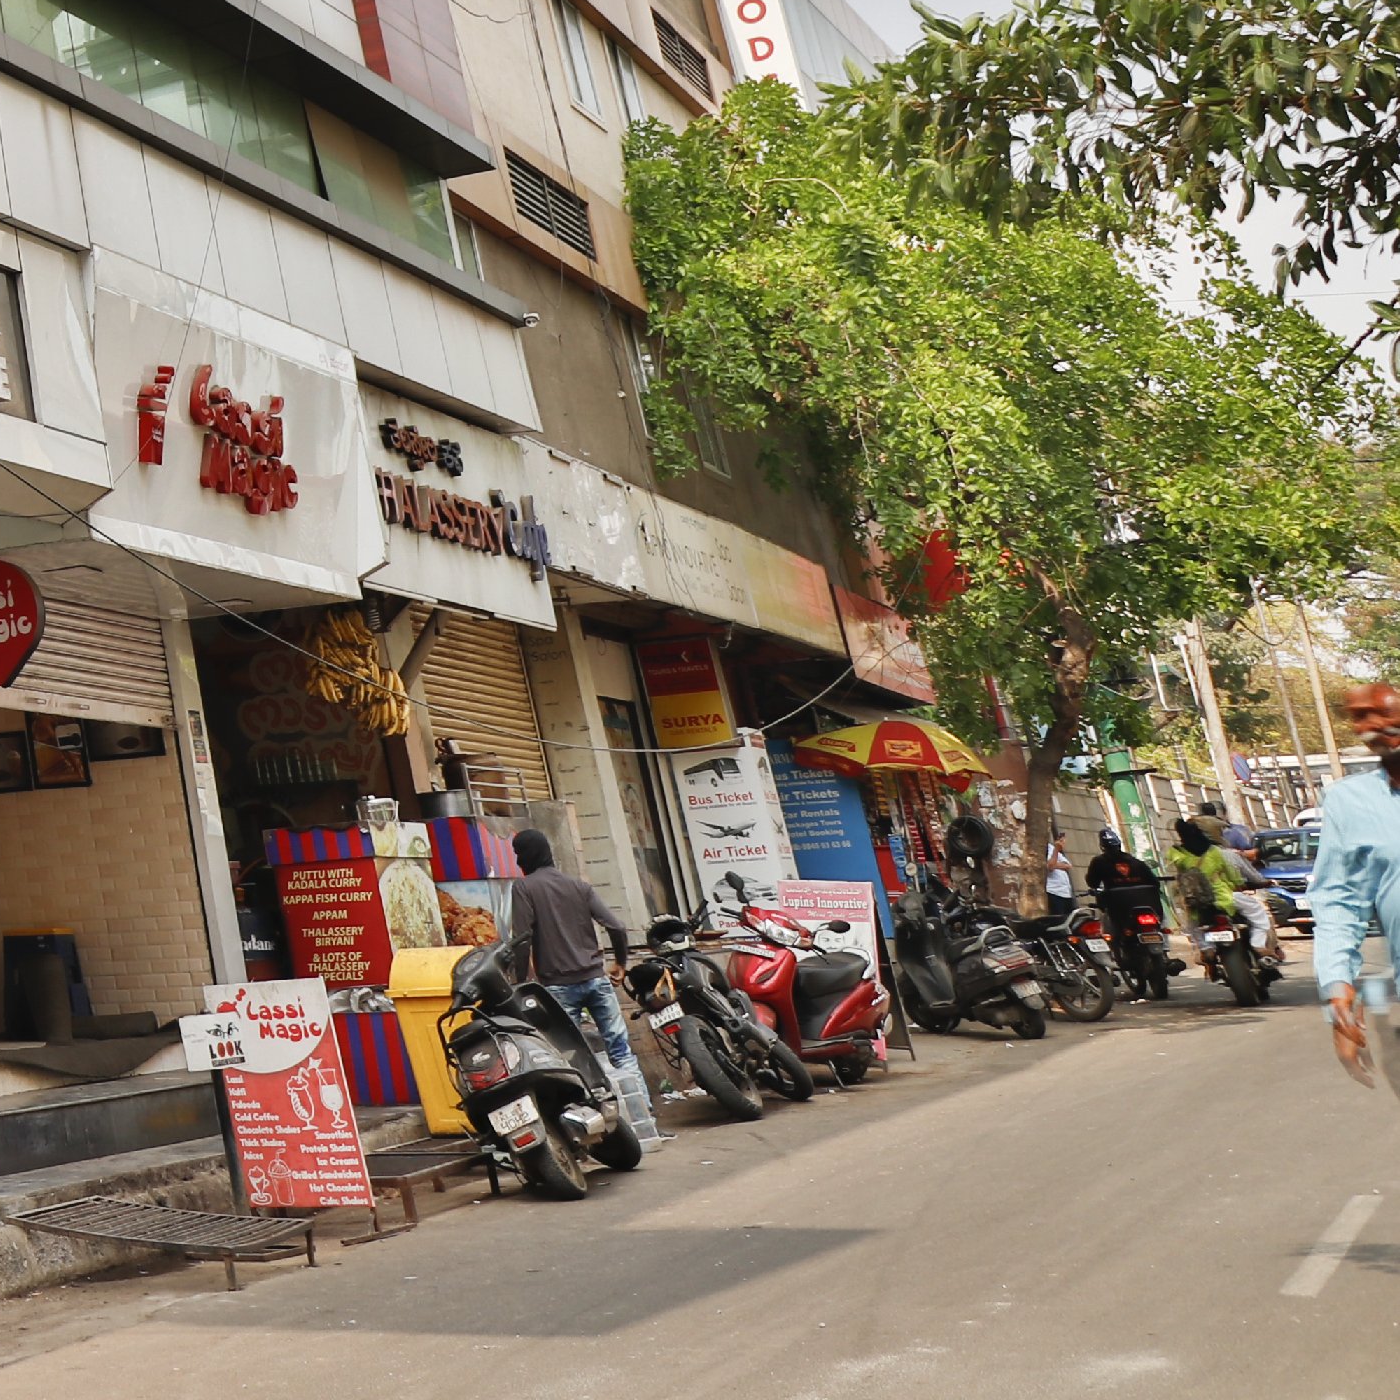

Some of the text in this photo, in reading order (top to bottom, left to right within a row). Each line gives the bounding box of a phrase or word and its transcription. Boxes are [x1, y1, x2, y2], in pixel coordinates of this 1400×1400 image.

[374, 466, 504, 556] HALASSERY
[662, 713, 725, 729] SURYA
[688, 795, 713, 806] Bus
[715, 791, 754, 803] Ticket
[792, 789, 840, 800] Tickets
[703, 845, 768, 860] Air Ticket
[293, 868, 353, 880] PUTTU WITH
[288, 878, 362, 890] KADALA CURRY
[283, 892, 373, 905] KAPPA FISH CURRY
[782, 896, 868, 909] Lupins Innovative
[312, 910, 348, 920] APPAM
[302, 926, 364, 937] THALASSERY
[315, 936, 354, 946] BIRYANI
[313, 951, 362, 962] & LOTS OF
[308, 961, 370, 972] THALASSERY
[246, 996, 305, 1020] Lassi
[259, 1020, 322, 1042] Magic
[209, 1041, 244, 1059] LOOK
[237, 1126, 301, 1134] Chocolate Shakes
